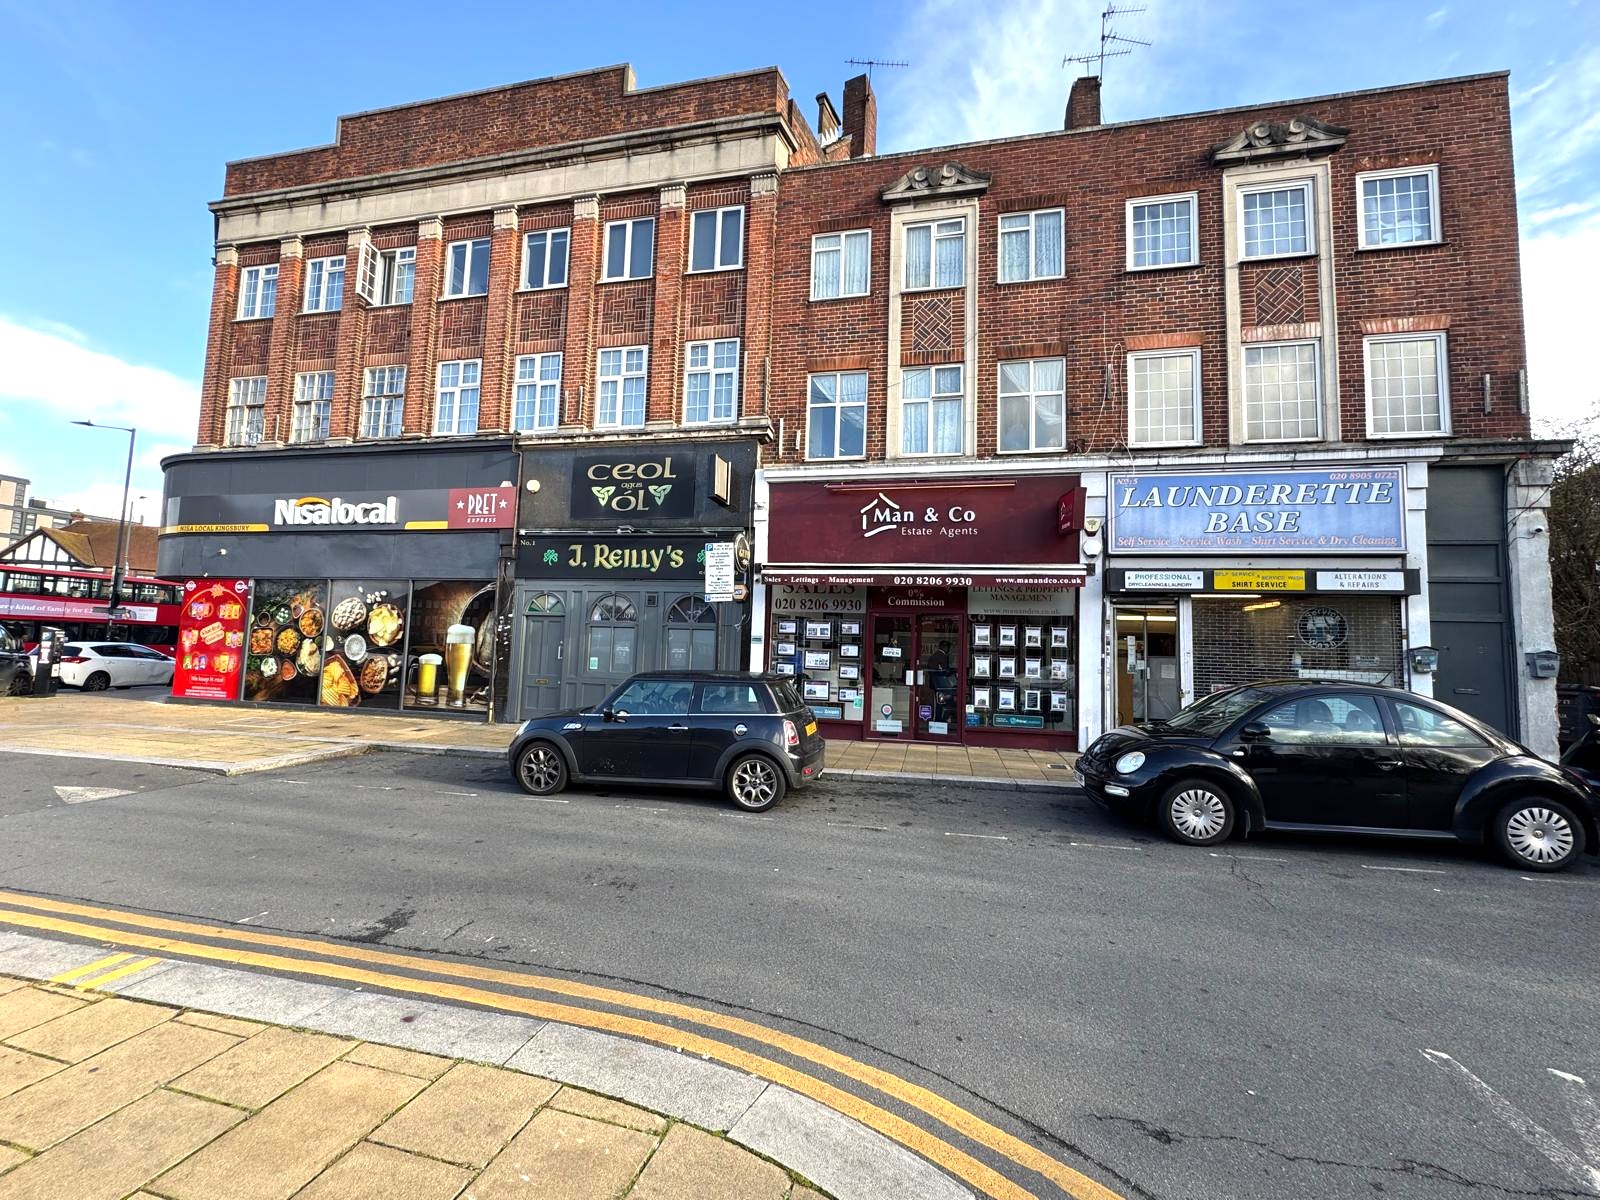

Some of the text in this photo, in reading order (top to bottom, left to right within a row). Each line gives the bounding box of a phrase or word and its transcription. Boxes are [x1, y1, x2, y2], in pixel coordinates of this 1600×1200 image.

[1374, 471, 1397, 479] 0722
[1120, 482, 1394, 507] LAUNDERETTE
[468, 493, 498, 514] PRET
[874, 506, 976, 522] Man & Co
[1204, 511, 1301, 533] BASE
[901, 527, 978, 537] Estate Agents
[1118, 537, 1135, 547] Self
[1138, 537, 1169, 545] Service
[1180, 537, 1212, 545] Service
[1216, 537, 1242, 545] Wash
[1252, 536, 1276, 545] Shirt
[1279, 536, 1315, 545] Service
[1318, 536, 1326, 545] &
[1329, 536, 1348, 546] Dry
[1352, 535, 1397, 546] Cleaning
[568, 544, 587, 568] J.
[790, 576, 819, 584] Lettings
[828, 576, 874, 584] Management
[893, 577, 973, 586] 020 8206 9930
[995, 576, 1082, 584] www.manandco.co.uk
[888, 597, 945, 607] Commission
[990, 593, 1053, 601] MANAGEMENT
[775, 599, 862, 611] 020 8206 9930
[47, 606, 70, 615] family
